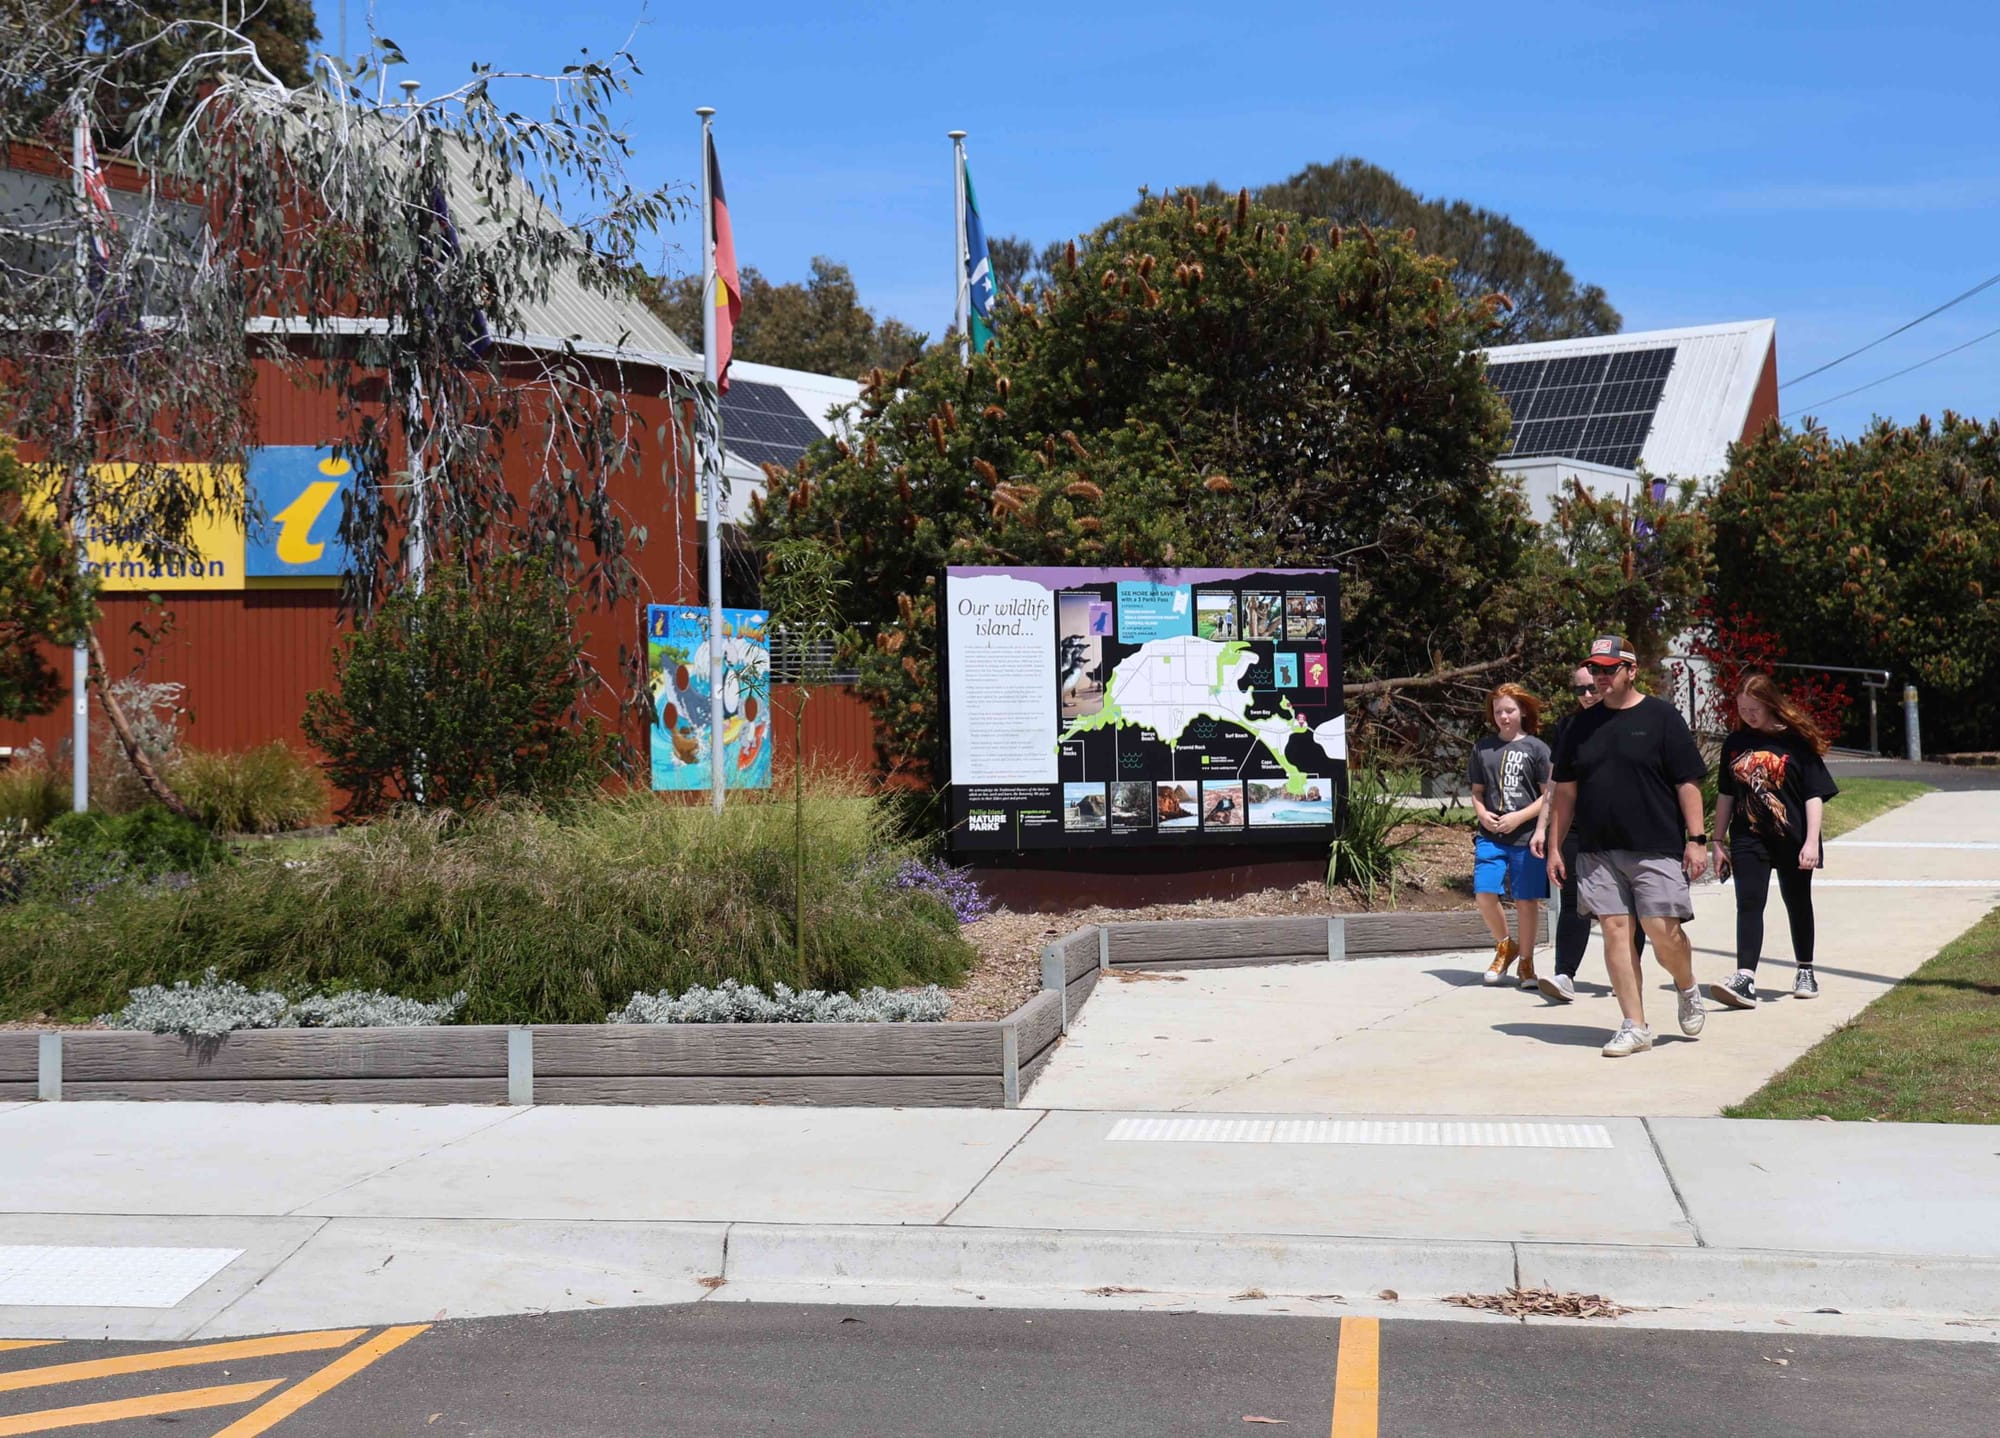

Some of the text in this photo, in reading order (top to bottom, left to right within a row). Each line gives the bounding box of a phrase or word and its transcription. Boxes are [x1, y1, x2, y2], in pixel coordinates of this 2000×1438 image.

[88, 557, 225, 578] ormation
[958, 598, 1050, 621] Our wildlife
[976, 618, 1034, 636] island...
[969, 815, 1007, 823] NATURE
[969, 823, 1000, 831] PARKS
